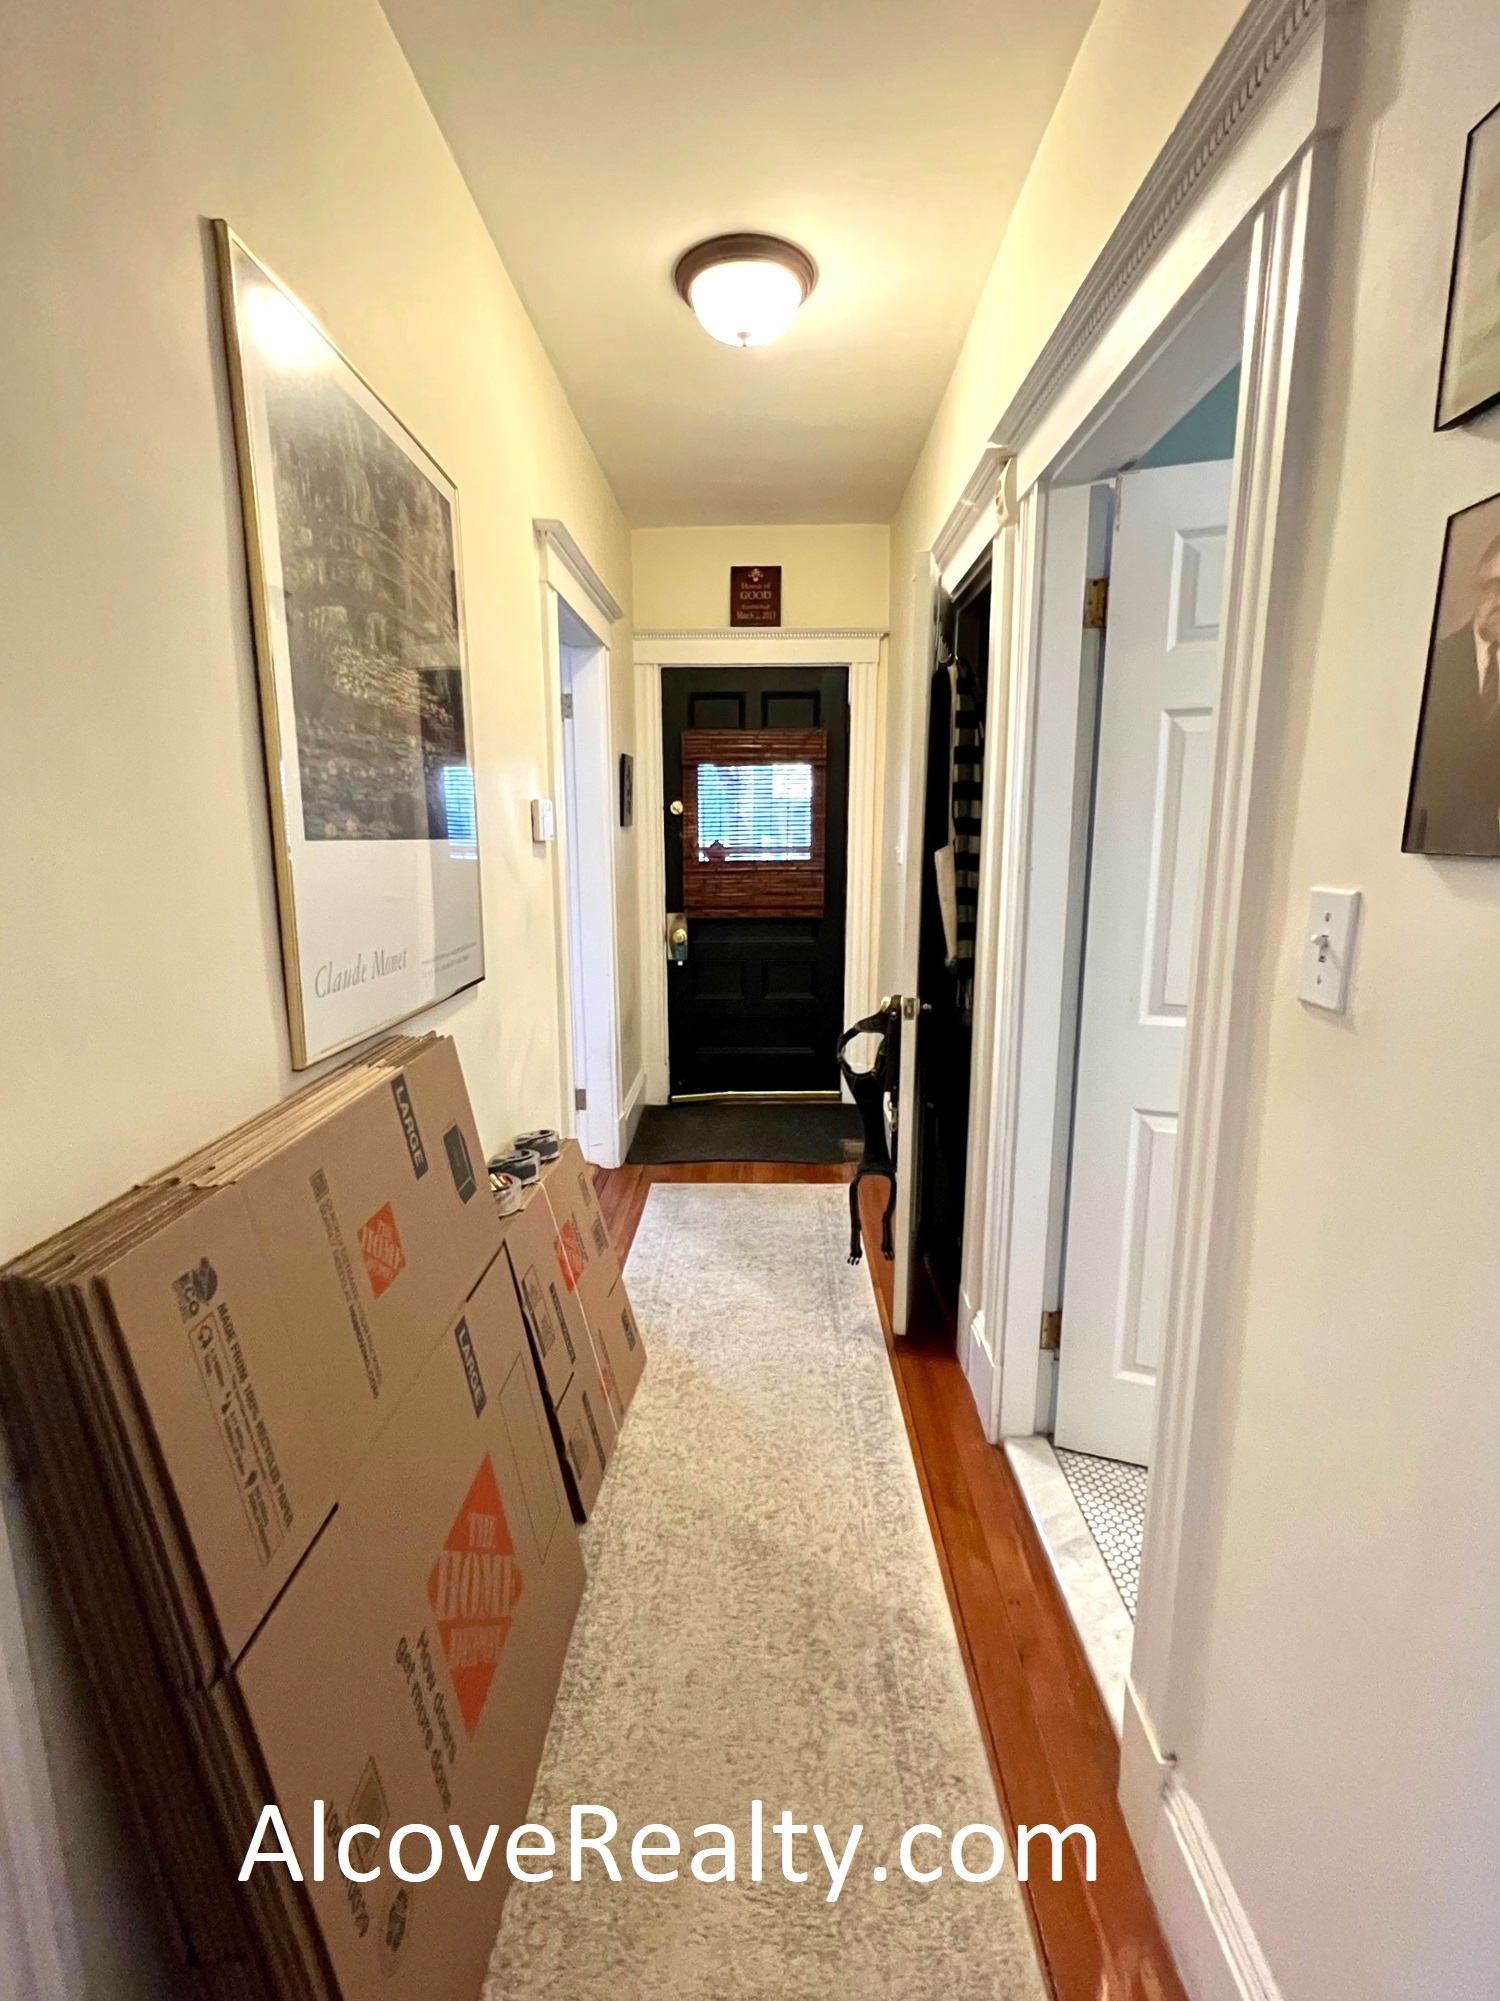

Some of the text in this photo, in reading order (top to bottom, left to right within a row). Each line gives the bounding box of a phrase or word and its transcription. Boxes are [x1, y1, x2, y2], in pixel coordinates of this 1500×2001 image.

[740, 590, 772, 600] GOOD
[314, 952, 367, 998] Claude
[371, 948, 407, 979] Monet
[395, 1085, 425, 1168] LARGE
[458, 1328, 482, 1406] LARGE
[217, 1302, 237, 1344] MADE
[231, 1342, 249, 1384] FROM
[244, 1383, 260, 1422] 100%
[256, 1418, 281, 1486] RECYCLED
[276, 1482, 294, 1529] PAPER
[436, 1549, 515, 1620] HOME
[395, 1636, 452, 1814] get more done
[417, 1627, 457, 1764] How doers
